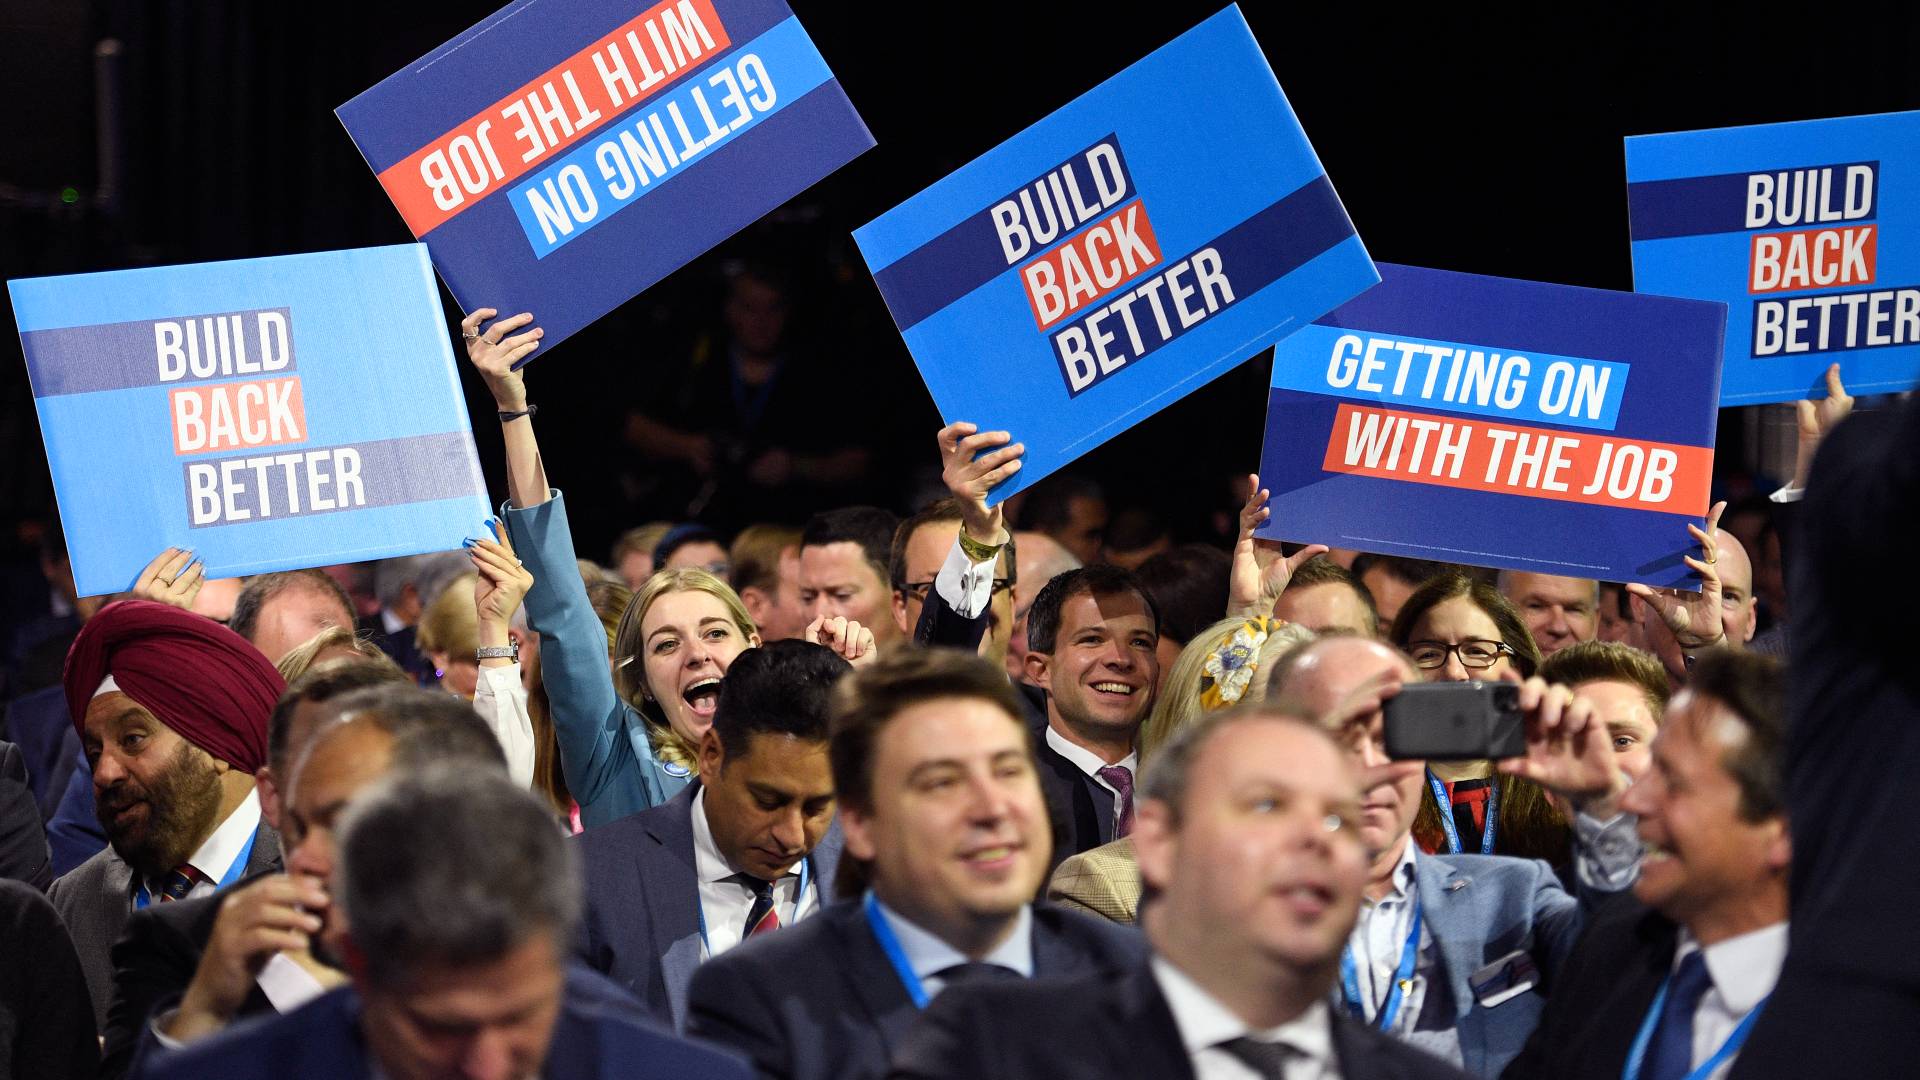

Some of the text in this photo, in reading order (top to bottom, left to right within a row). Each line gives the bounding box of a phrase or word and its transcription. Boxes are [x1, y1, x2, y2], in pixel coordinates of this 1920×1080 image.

[591, 0, 716, 107] WITH
[500, 69, 602, 164] THE
[525, 53, 777, 245] GETTING ON
[419, 119, 506, 212] JOB
[990, 143, 1127, 265] BUILD
[1746, 165, 1873, 228] BUILD
[1025, 205, 1156, 325] BACK
[1753, 228, 1871, 290] BACK
[154, 311, 291, 383] BUILD
[1055, 247, 1236, 392] BETTER
[1756, 289, 1920, 355] BETTER
[175, 379, 301, 451] BACK
[1326, 334, 1531, 410] GETTING
[1538, 361, 1612, 420] ON
[188, 447, 366, 526] BETTER
[1344, 411, 1678, 503] WITH THE JOB
